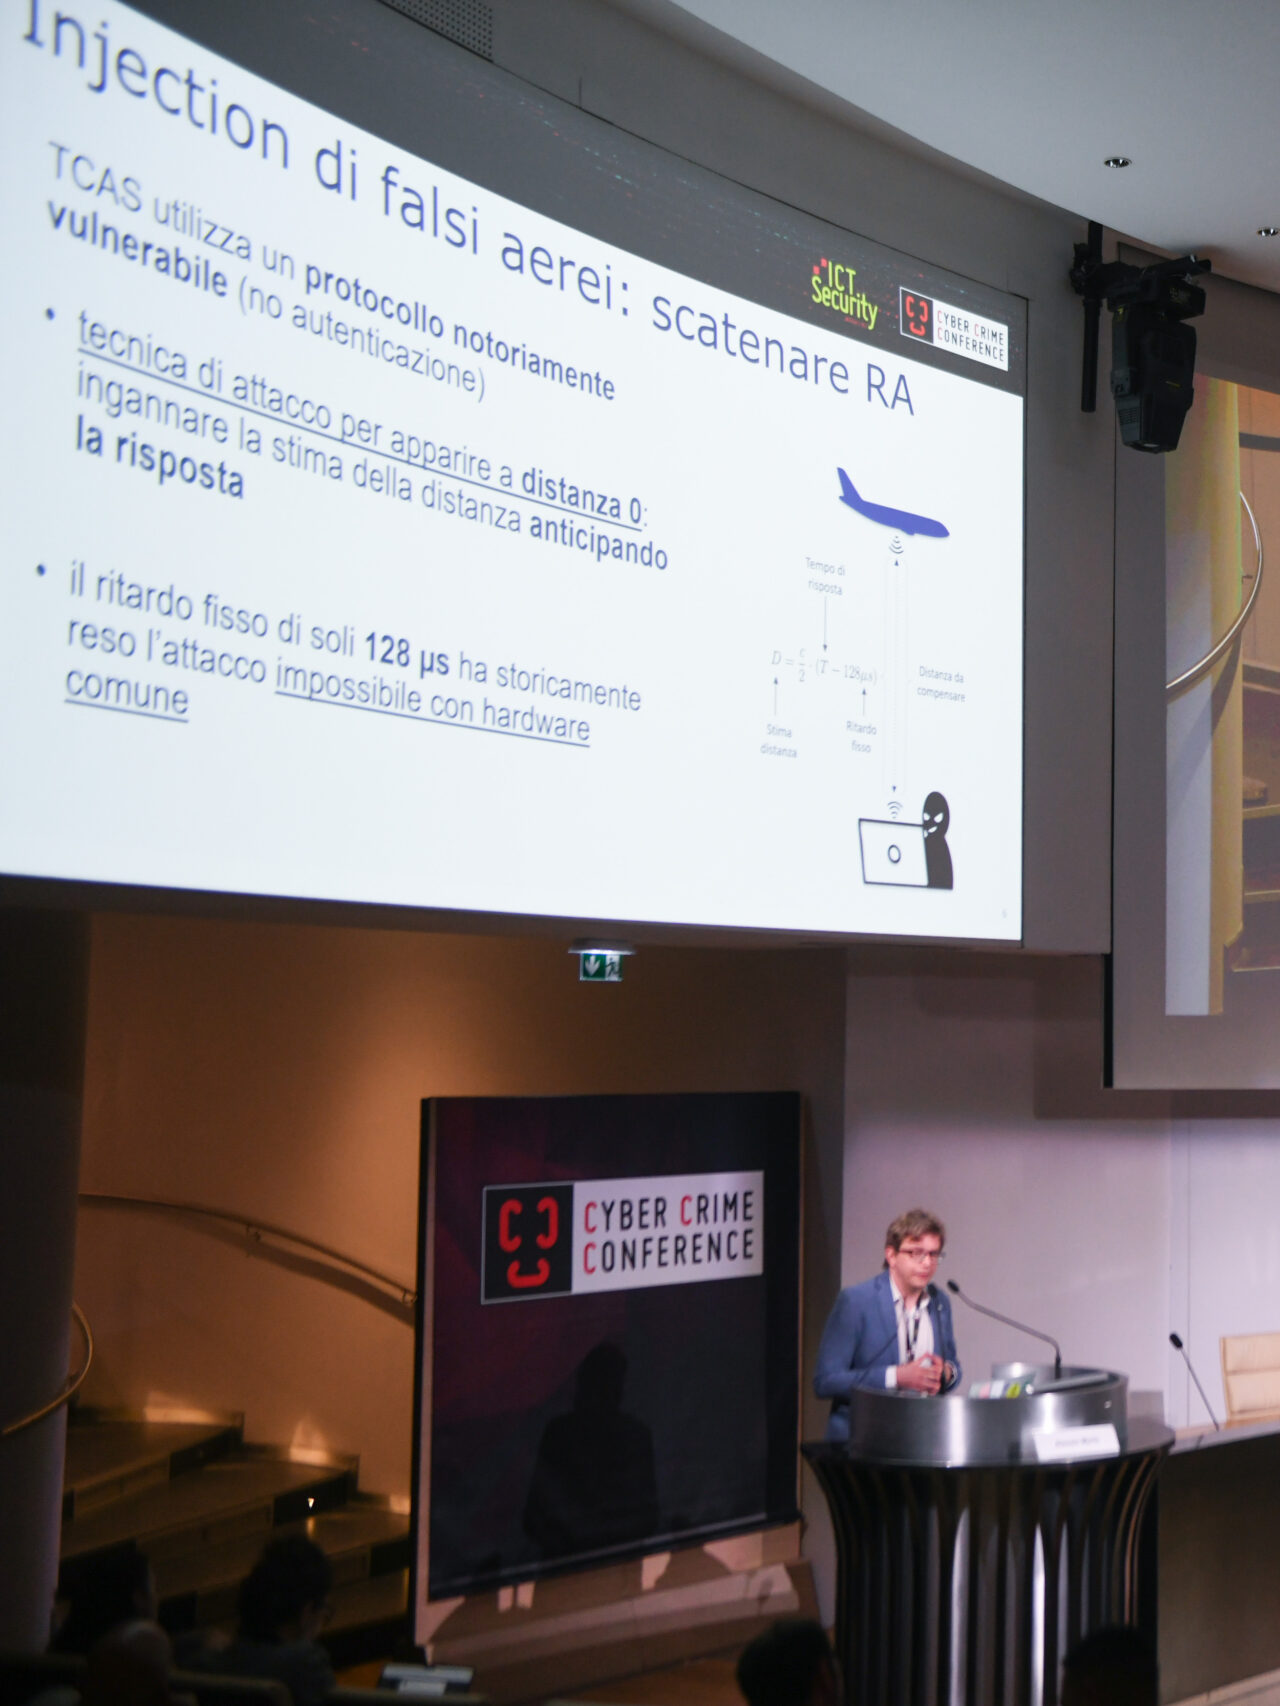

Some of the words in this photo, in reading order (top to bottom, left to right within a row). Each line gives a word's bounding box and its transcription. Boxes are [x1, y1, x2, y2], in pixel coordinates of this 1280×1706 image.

[23, 0, 289, 168] Injection
[315, 139, 357, 201] di
[381, 165, 479, 255] falsi
[501, 231, 629, 316] aerei:
[653, 294, 849, 394] scatenare
[867, 363, 915, 416] RA
[48, 141, 141, 211] TCAS
[154, 196, 251, 261] utilizza
[263, 245, 295, 280] un
[305, 264, 443, 338] protocollo
[454, 323, 615, 400] notoriamente
[828, 261, 856, 295] ICT
[48, 200, 228, 297] vulnerabile
[239, 276, 282, 316] (no
[292, 300, 486, 403] autenticazione)
[811, 275, 878, 330] Security
[937, 310, 969, 333] CYBER
[974, 323, 1004, 345] CRIME
[937, 327, 1004, 362] CONFERENCE
[79, 310, 187, 379] tecnica
[199, 357, 222, 393] di
[233, 374, 331, 429] attacco
[340, 412, 382, 446] per
[391, 430, 490, 481] apparire
[500, 465, 512, 488] a
[522, 467, 621, 519] distanza
[77, 413, 102, 456] la
[117, 431, 243, 499] risposta
[78, 360, 228, 443] ingannare
[239, 416, 261, 454] la
[273, 435, 343, 480] stima
[353, 458, 412, 502] della
[422, 479, 521, 533] distanza
[530, 514, 668, 570] anticipando
[806, 557, 835, 576] Tempo
[837, 565, 846, 576] di
[808, 579, 842, 596] risposta
[71, 559, 84, 597] il
[97, 569, 193, 621] ritardo
[203, 593, 268, 638] fisso
[278, 612, 301, 645] di
[311, 624, 354, 657] soli
[365, 631, 410, 667] 128
[460, 651, 487, 684] ha
[497, 662, 641, 711] storicamente
[65, 669, 189, 715] comune
[68, 619, 136, 657] reso
[276, 656, 421, 712] impossibile
[431, 694, 473, 722] con
[483, 697, 590, 742] hardware
[917, 686, 965, 703] compensare
[919, 665, 953, 682] Distanza
[955, 673, 964, 684] da
[767, 723, 792, 738] Stima
[846, 720, 877, 735] Ritardo
[760, 743, 797, 758] distanza
[584, 1197, 666, 1234] CYBER
[680, 1190, 754, 1226] CRIME
[583, 1229, 754, 1274] CONFERENCE
